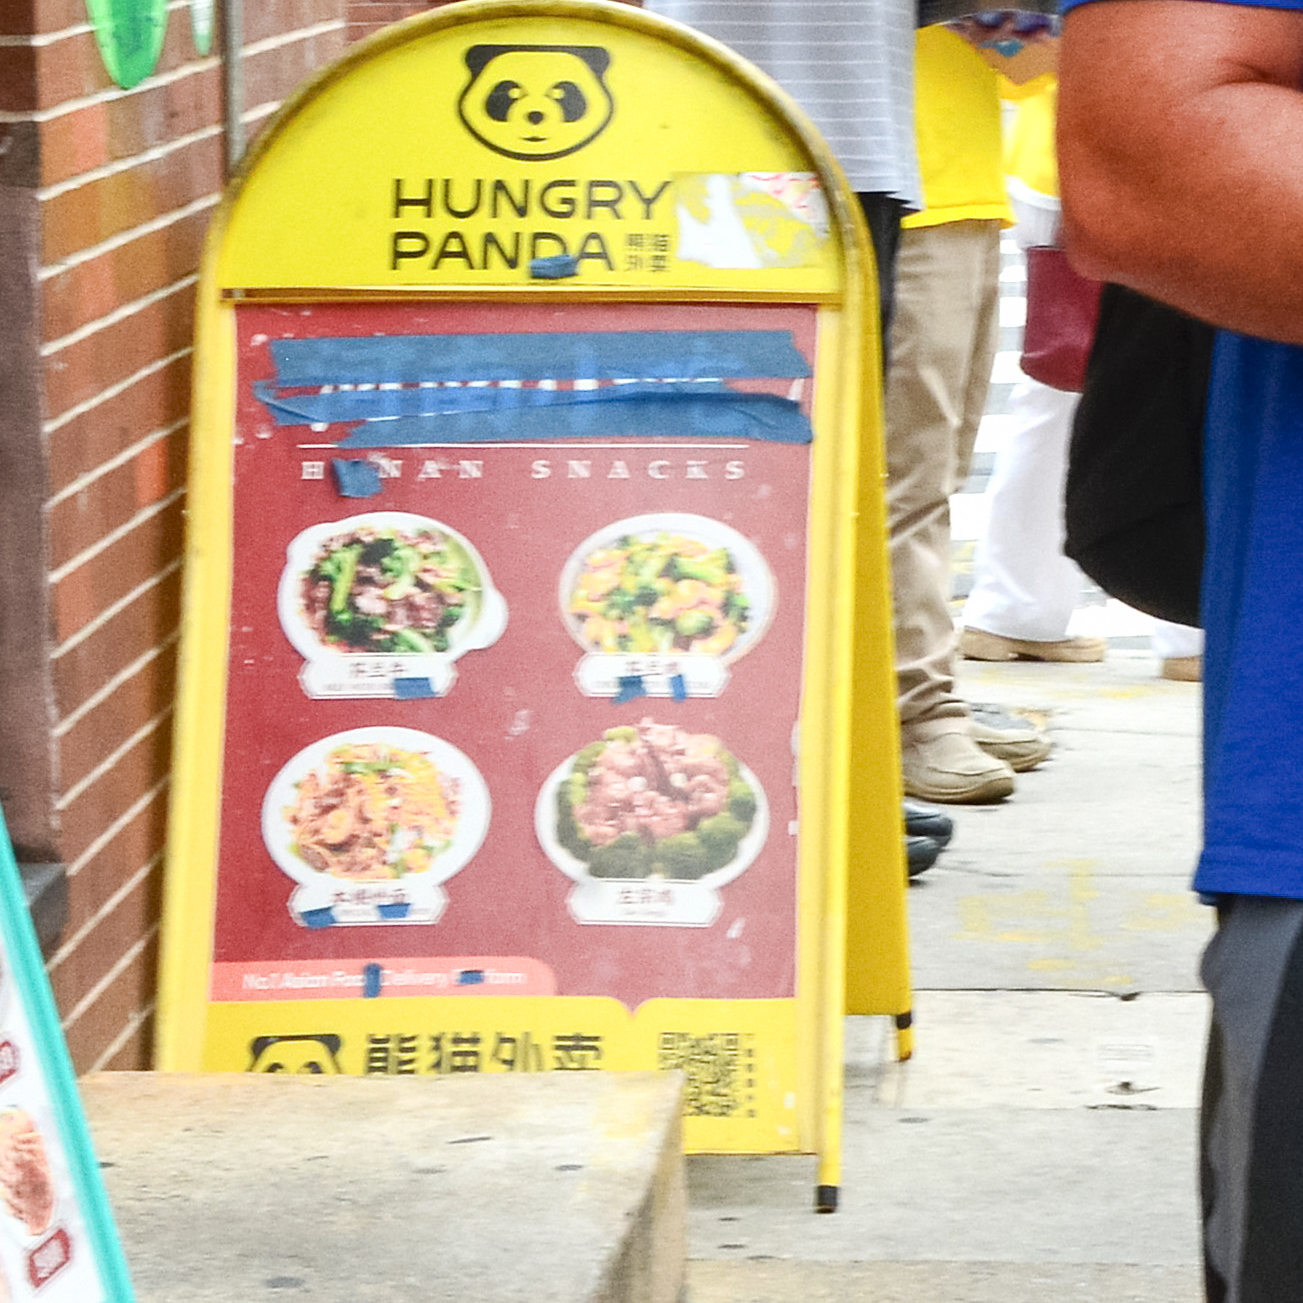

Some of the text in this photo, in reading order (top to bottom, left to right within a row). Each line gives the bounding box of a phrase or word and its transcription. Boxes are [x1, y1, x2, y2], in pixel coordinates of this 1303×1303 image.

[391, 178, 673, 220] HUNGRY
[391, 230, 616, 272] PANDA
[301, 459, 746, 480] HNAN SNACKS
[281, 972, 328, 989] Asian
[330, 971, 367, 988] Foo
